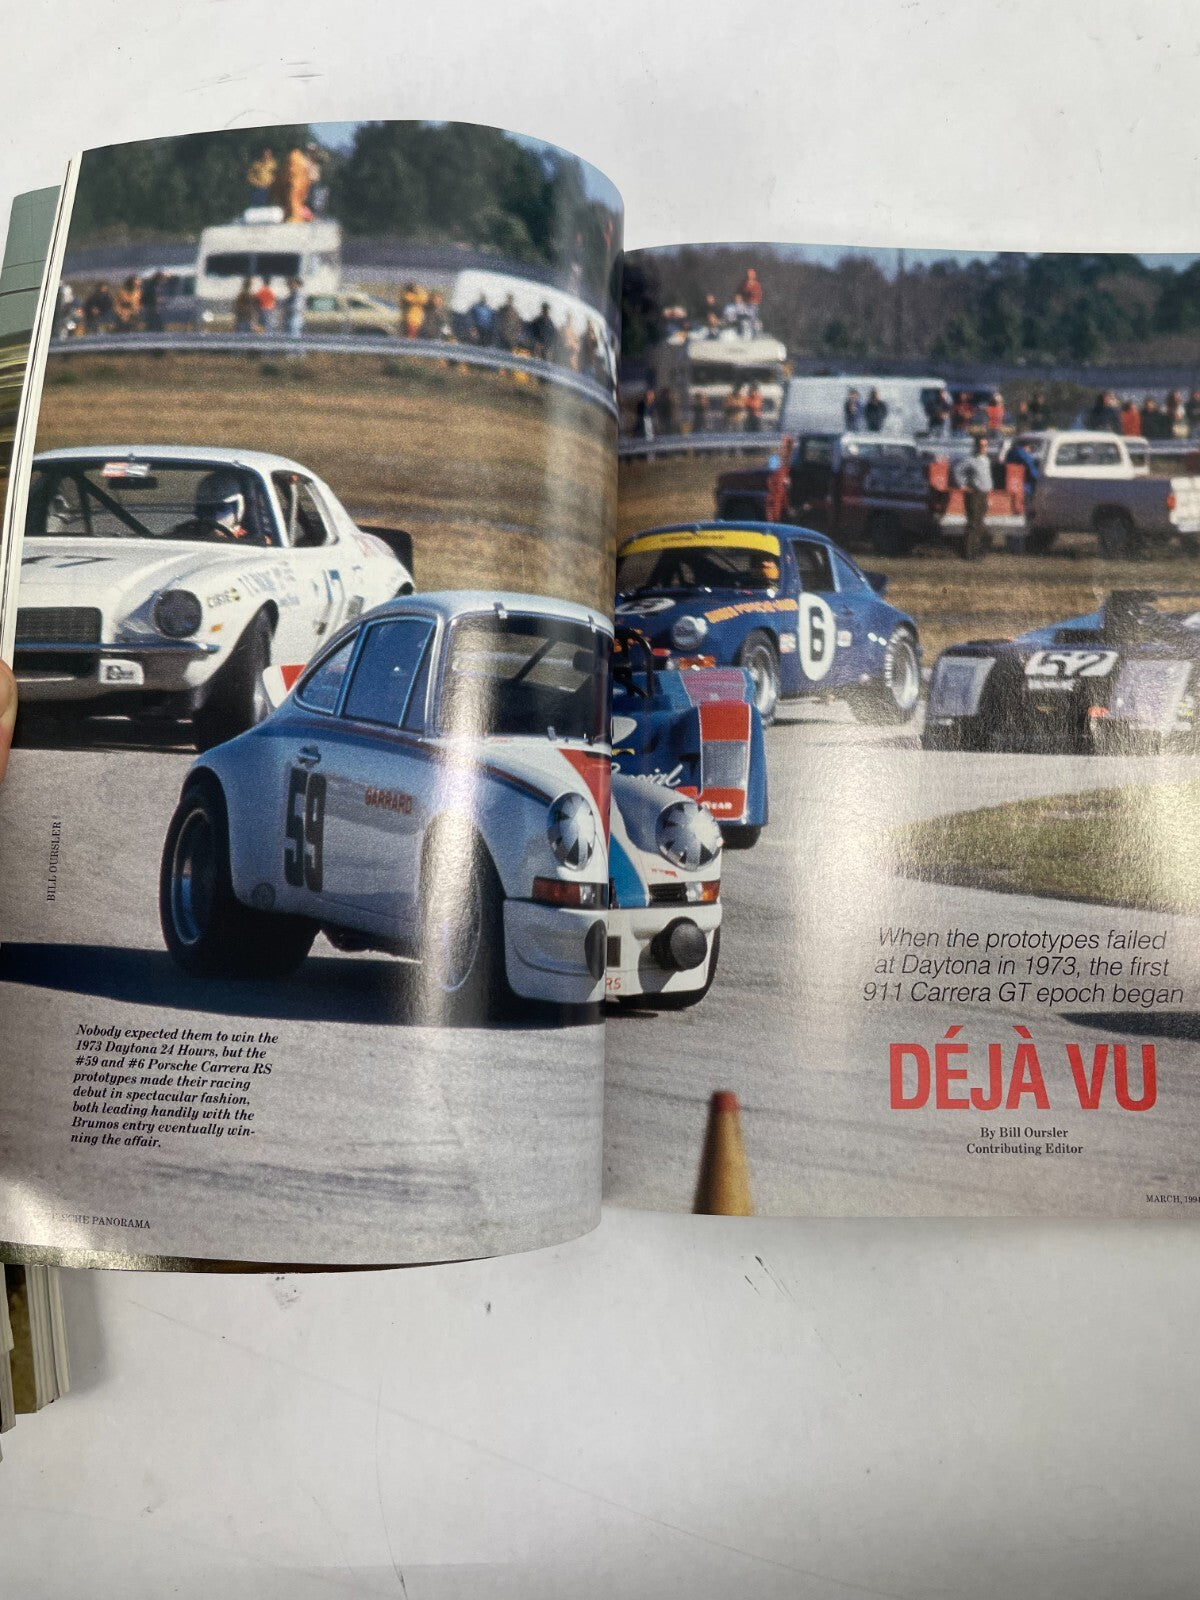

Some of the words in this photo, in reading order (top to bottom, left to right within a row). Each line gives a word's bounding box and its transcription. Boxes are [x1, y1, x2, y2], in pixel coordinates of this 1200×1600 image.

[809, 607, 826, 662] 6
[284, 767, 326, 892] 59
[48, 822, 61, 873] OURSLER
[46, 875, 57, 901] BILL
[879, 927, 939, 948] When
[946, 929, 979, 948] the
[986, 930, 1099, 953] prototypes
[1107, 930, 1167, 950] failed
[875, 957, 895, 974] at
[902, 955, 991, 978] Daytona
[998, 957, 1015, 975] in
[1026, 956, 1080, 978] 1973,
[1090, 957, 1123, 976] the
[1130, 957, 1169, 977] first
[863, 982, 902, 1001] 911
[911, 982, 991, 1002] Carrera
[999, 983, 1031, 1002] GT
[1037, 984, 1105, 1007] epoch
[1112, 984, 1184, 1007] began
[77, 1025, 122, 1038] Nobody
[125, 1028, 179, 1040] expected
[181, 1029, 212, 1041] them
[216, 1031, 228, 1042] to
[232, 1032, 254, 1042] win
[258, 1032, 279, 1044] the
[75, 1040, 102, 1052] 1973
[105, 1041, 157, 1055] Daytona
[161, 1044, 174, 1055] 24
[177, 1045, 218, 1057] Hours,
[222, 1046, 243, 1057] but
[247, 1047, 267, 1058] the
[75, 1056, 99, 1067] #59
[101, 1057, 124, 1068] and
[128, 1058, 145, 1069] #6
[148, 1059, 198, 1072] Porsche
[201, 1061, 249, 1073] Carrera
[253, 1063, 273, 1074] RS
[889, 1025, 1051, 1111] DÉJÀ
[1065, 1044, 1157, 1111] VU
[73, 1072, 137, 1085] prototypes
[140, 1075, 174, 1086] made
[177, 1076, 208, 1088] their
[210, 1079, 251, 1091] racing
[73, 1087, 107, 1098] debut
[111, 1088, 123, 1099] in
[126, 1090, 198, 1103] spectacular
[200, 1093, 250, 1106] fashion,
[72, 1102, 99, 1113] both
[102, 1103, 148, 1117] leading
[151, 1106, 199, 1120] handily
[203, 1109, 231, 1120] with
[234, 1110, 255, 1121] the
[72, 1117, 119, 1129] Brumos
[122, 1121, 155, 1133] entry
[158, 1122, 224, 1136] eventually
[227, 1126, 255, 1136] win-
[980, 1127, 995, 1139] By
[999, 1127, 1021, 1138] Bill
[1024, 1127, 1069, 1138] Oursler
[71, 1133, 98, 1145] ning
[102, 1135, 122, 1145] the
[124, 1135, 161, 1148] affair.
[966, 1143, 1042, 1155] Contributing
[1045, 1143, 1084, 1154] Editor
[1146, 1195, 1183, 1204] MARCH,
[92, 1216, 151, 1229] PANORAMA
